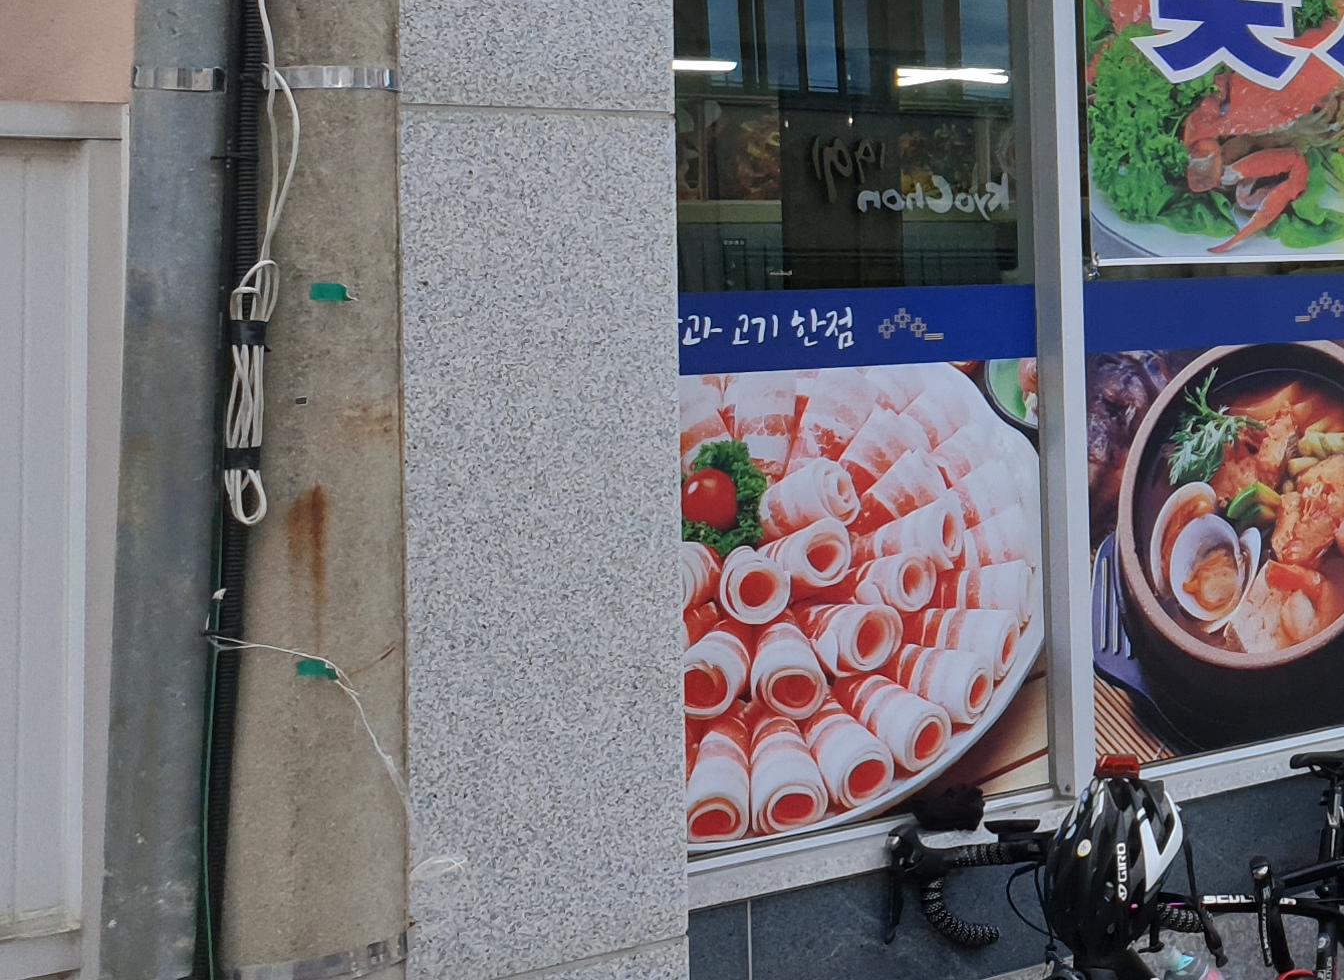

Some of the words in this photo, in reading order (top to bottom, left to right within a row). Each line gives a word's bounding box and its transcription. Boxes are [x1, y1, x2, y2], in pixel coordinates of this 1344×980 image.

[679, 314, 723, 345] 과
[732, 313, 779, 345] 고기
[790, 306, 855, 350] 한점
[1115, 842, 1127, 883] GIRO
